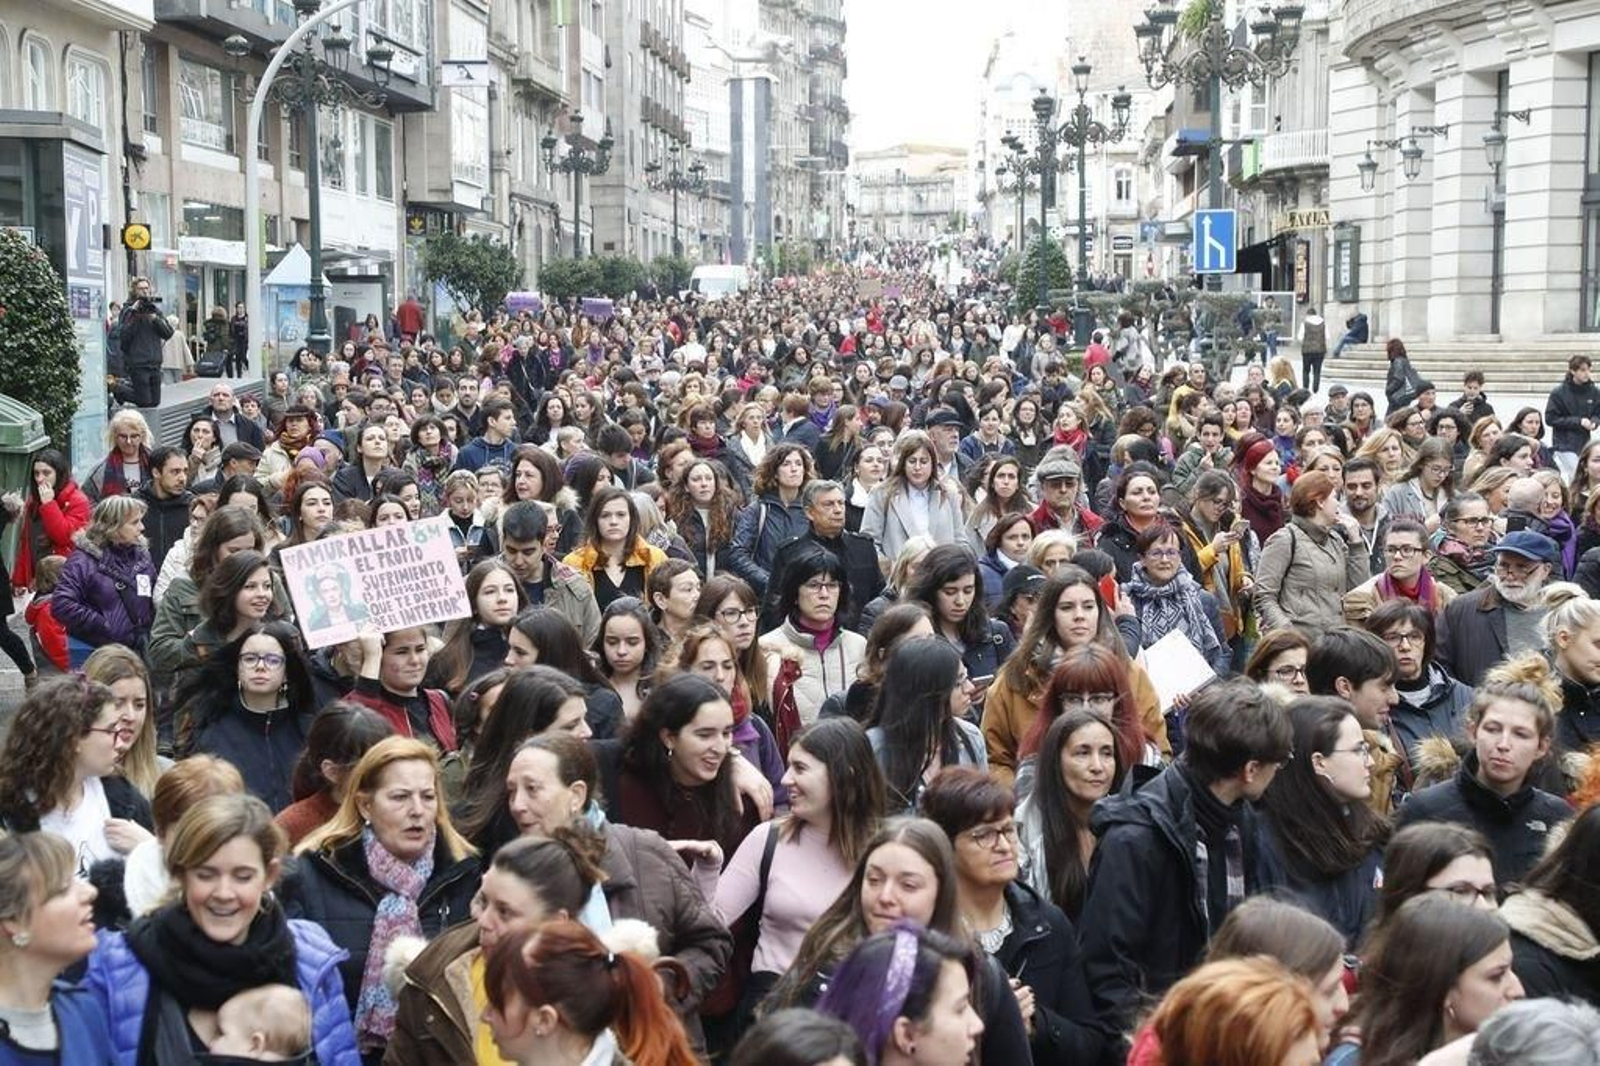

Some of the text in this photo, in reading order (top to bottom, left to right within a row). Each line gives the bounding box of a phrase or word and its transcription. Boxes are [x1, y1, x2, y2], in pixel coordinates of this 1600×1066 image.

[355, 546, 424, 573] EL PROPIO
[362, 560, 446, 591] SUFRIMIENTO
[444, 574, 453, 587] A
[370, 587, 449, 616] QUE TE DEVORE
